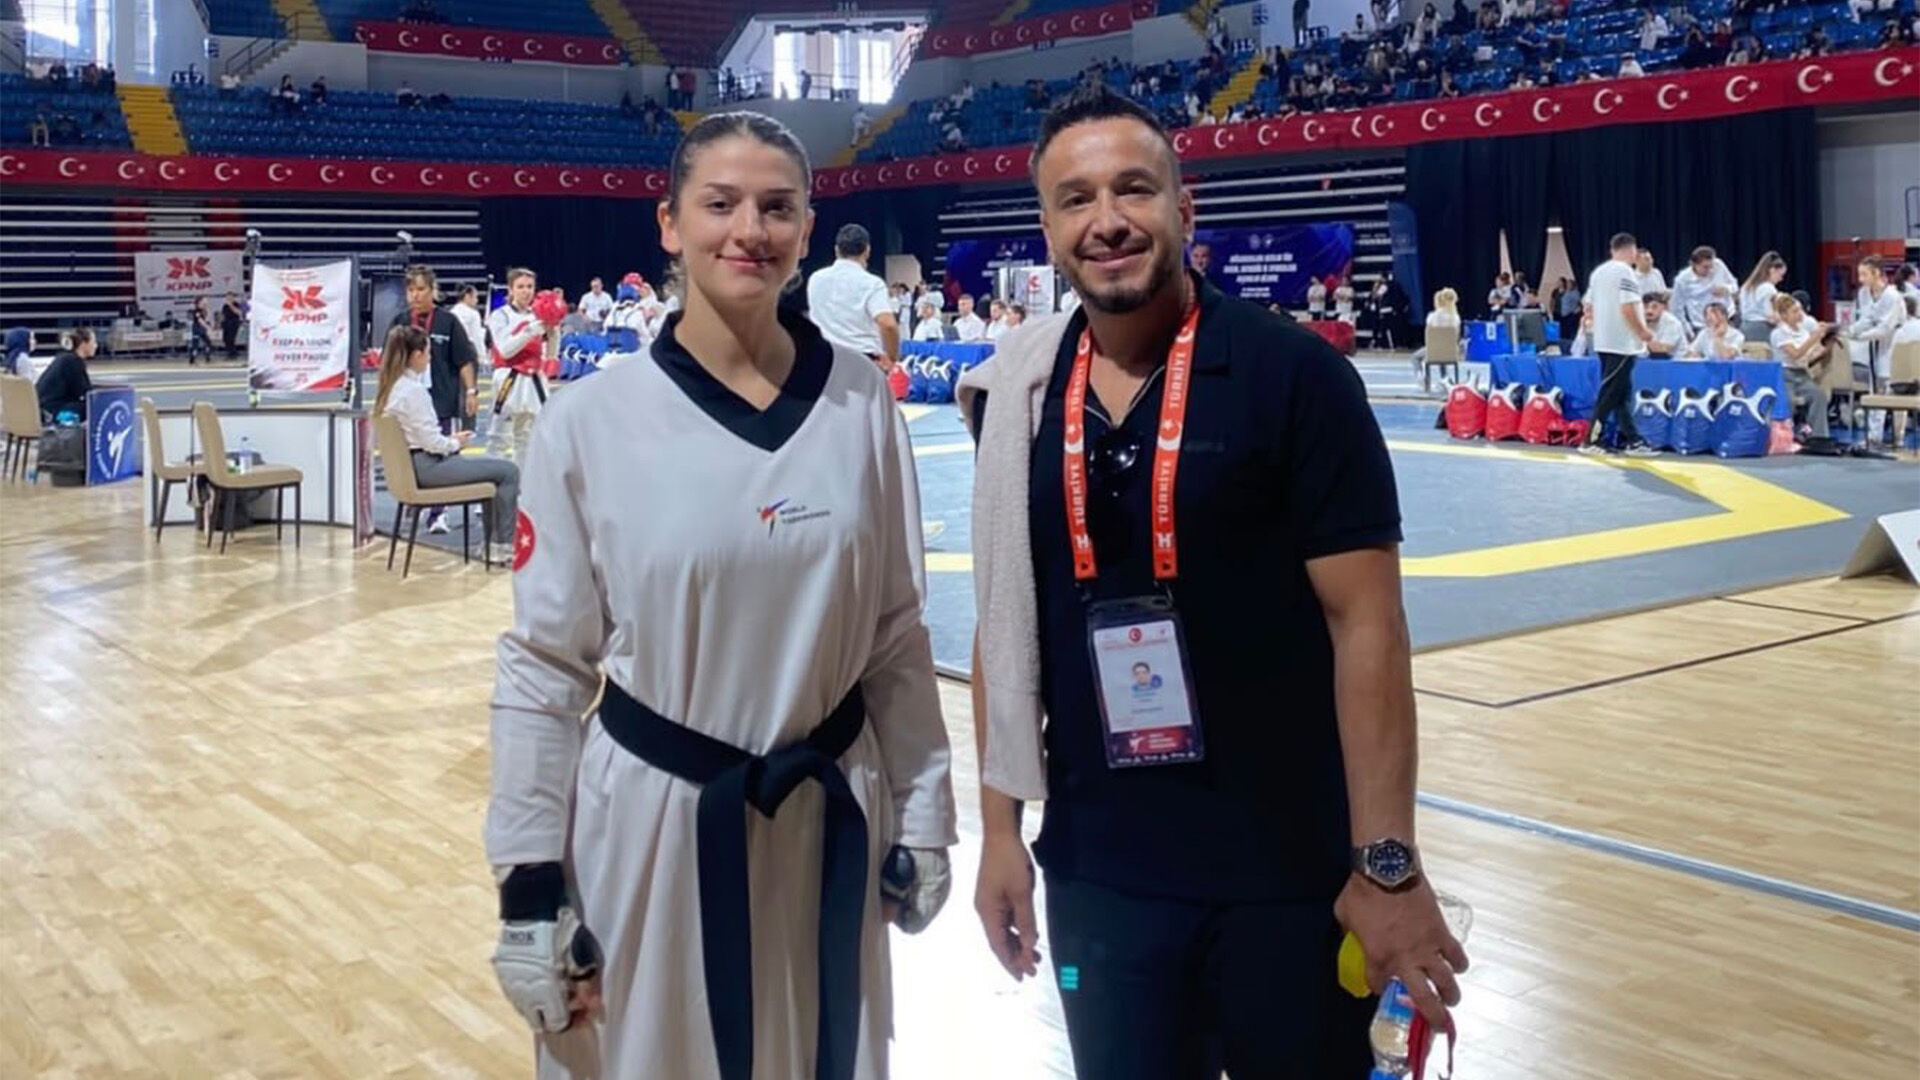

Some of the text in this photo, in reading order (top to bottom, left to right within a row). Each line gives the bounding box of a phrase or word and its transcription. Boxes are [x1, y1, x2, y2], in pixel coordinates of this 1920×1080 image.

[165, 281, 213, 292] KPNP
[1069, 462, 1085, 526] TÜRKİYE
[1157, 460, 1172, 524] TÜRKİYE
